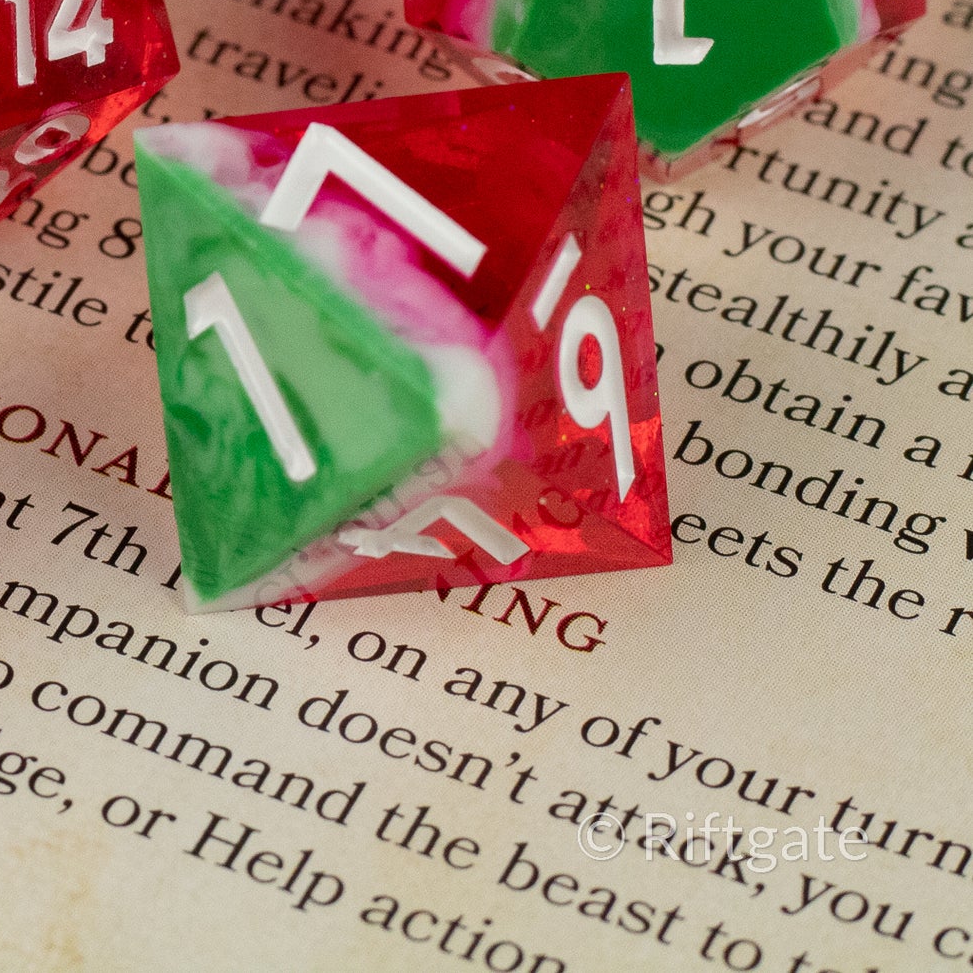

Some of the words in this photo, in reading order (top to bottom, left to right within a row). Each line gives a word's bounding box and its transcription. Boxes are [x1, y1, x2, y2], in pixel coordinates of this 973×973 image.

[260, 122, 487, 283] 7
[641, 190, 716, 237] gh
[723, 219, 881, 289] your
[725, 144, 945, 240] rtunity
[184, 271, 317, 484] 1
[647, 262, 931, 387] stealthily
[684, 358, 887, 449] obtain
[903, 434, 943, 469] a
[49, 500, 150, 577] 7th
[672, 420, 948, 555] bonding
[670, 511, 804, 578] eets
[820, 556, 927, 621] the
[31, 679, 368, 827] command
[375, 801, 483, 871] the
[498, 841, 687, 946] beast
[347, 629, 428, 682] on
[443, 666, 570, 734] any
[580, 715, 662, 759] of
[647, 738, 817, 817] your
[829, 795, 973, 879] turn
[100, 793, 177, 840] or
[183, 810, 347, 913] Help
[780, 873, 915, 943] you
